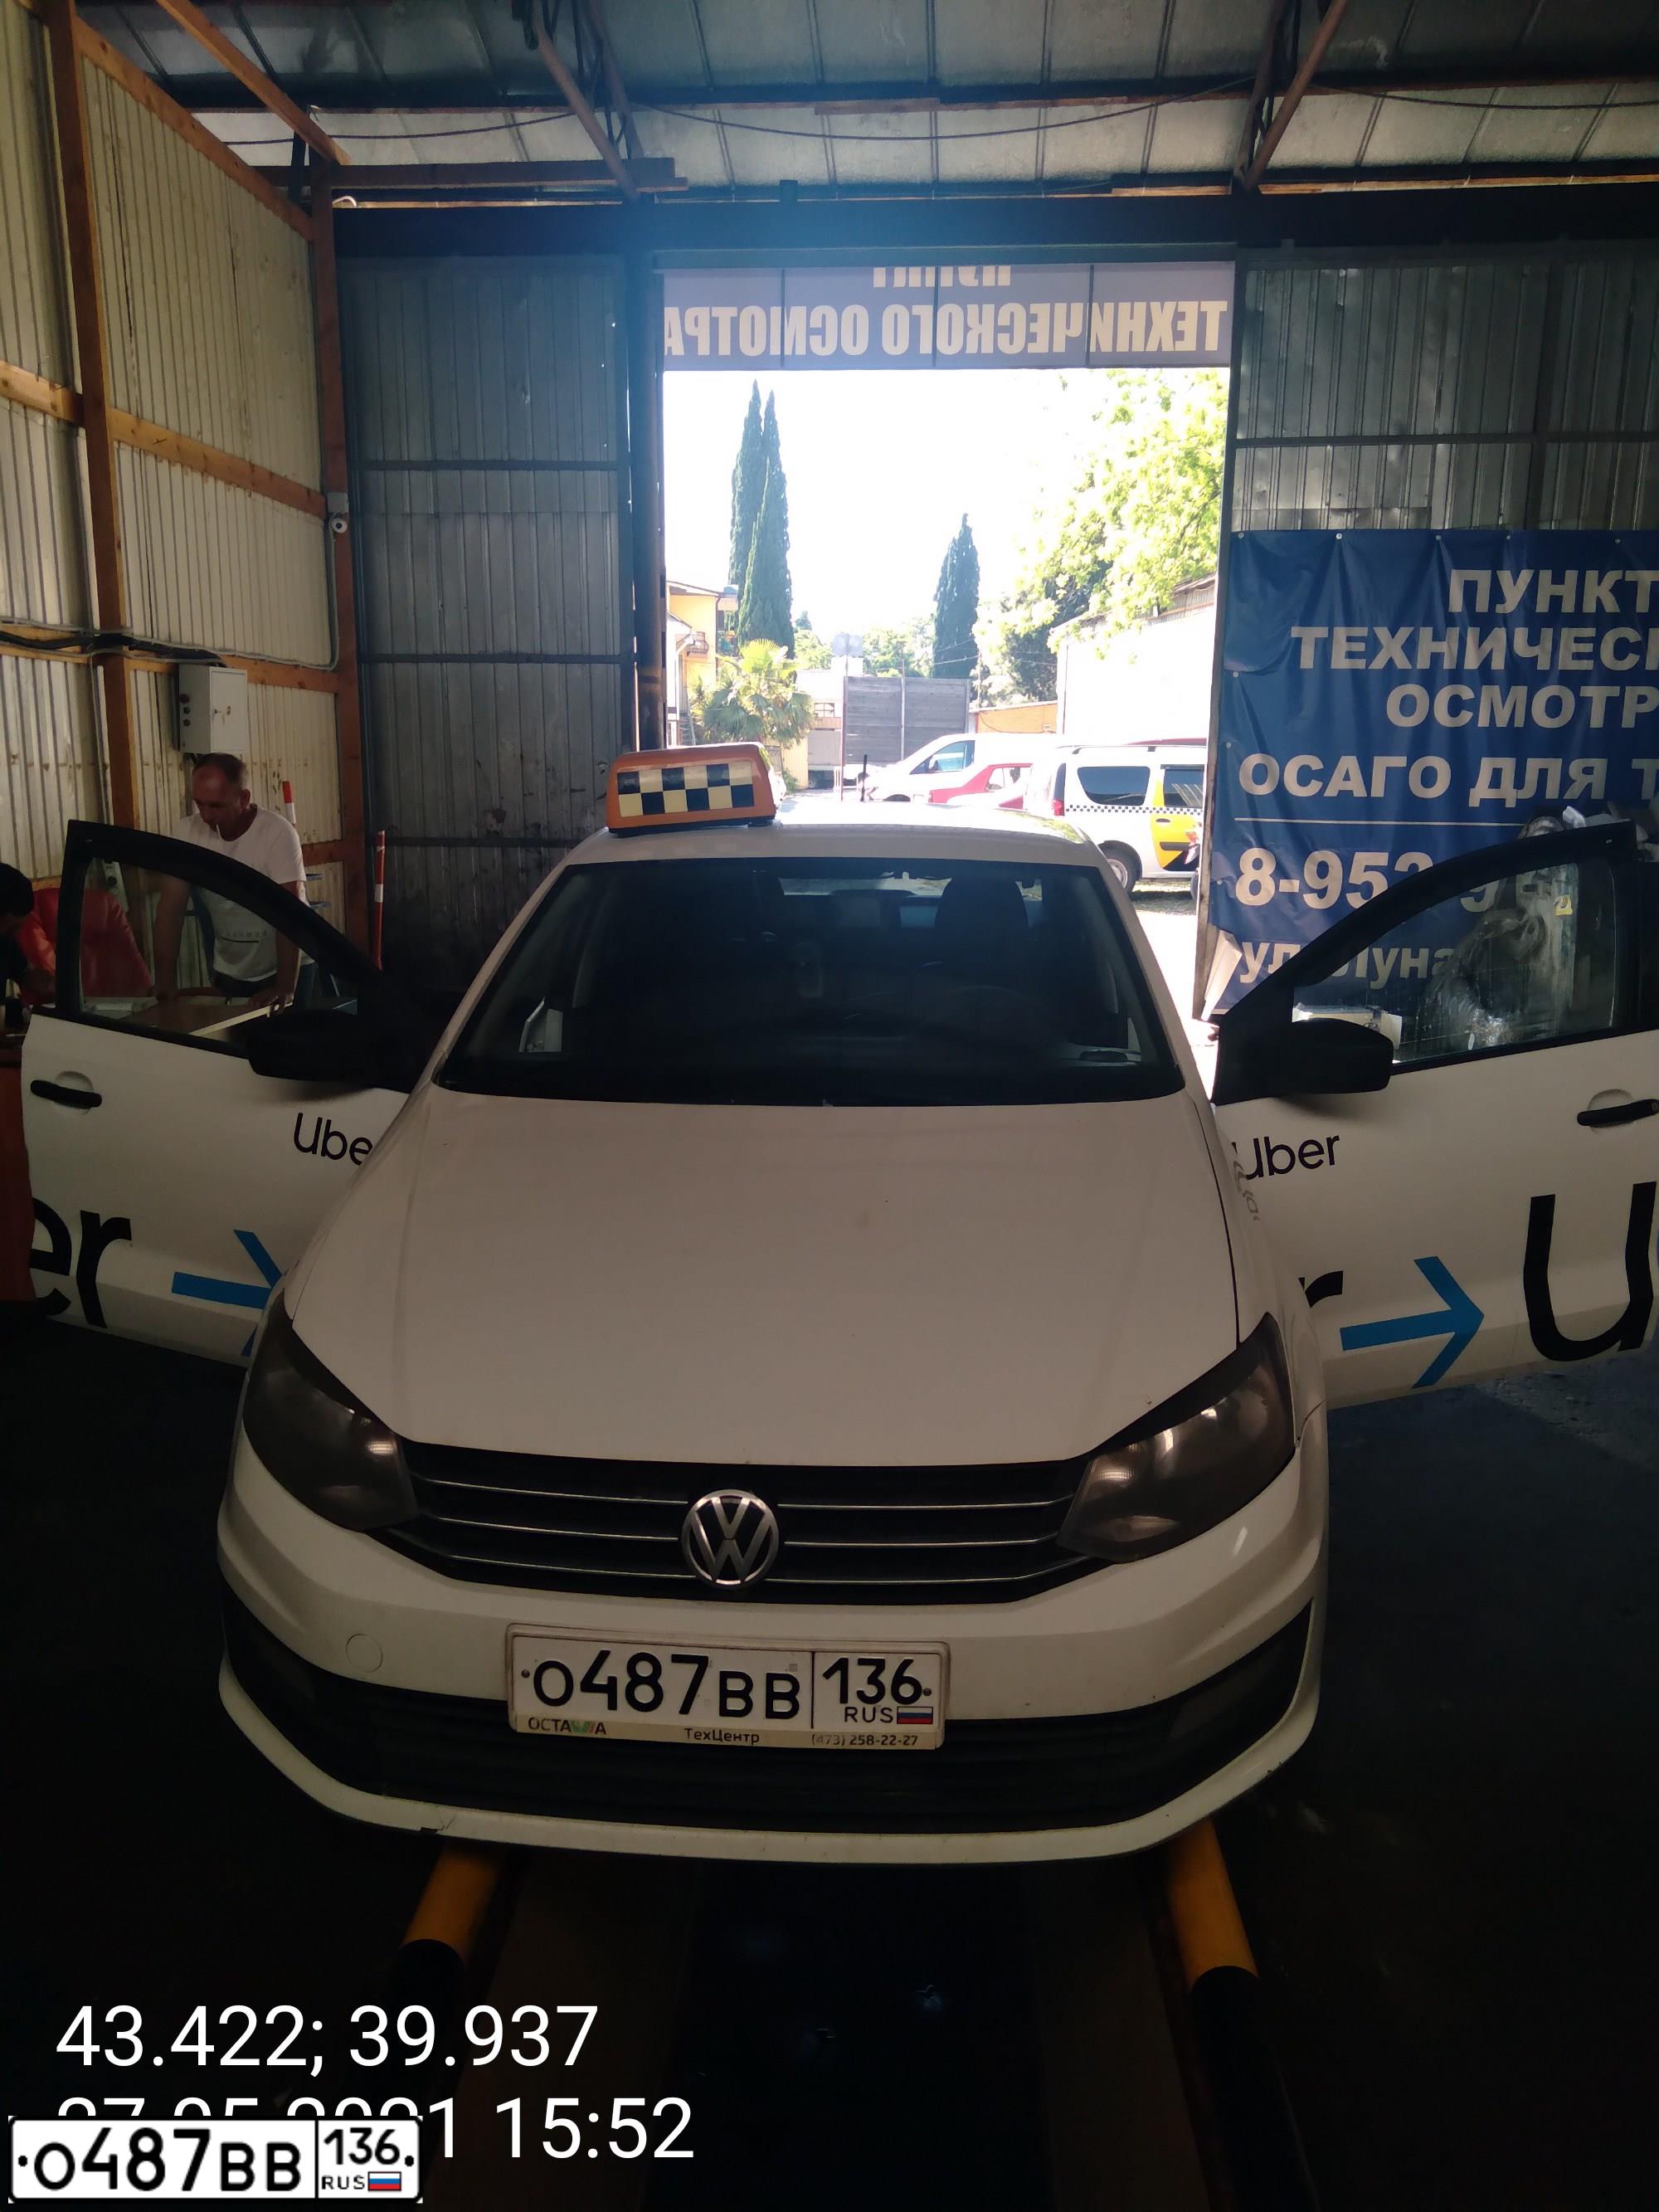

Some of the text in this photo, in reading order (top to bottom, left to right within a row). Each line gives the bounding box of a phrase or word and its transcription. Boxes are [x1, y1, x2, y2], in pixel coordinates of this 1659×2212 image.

[1448, 569, 1659, 613] ПУНКТ
[1386, 684, 1659, 728] ОСМОТР
[1238, 752, 1452, 798] ОСАГО
[1468, 757, 1608, 808] ДЛЯ
[822, 1657, 922, 1704] 136
[684, 1727, 761, 1744] ТехЦентр
[849, 1734, 919, 1747] 258-22-27
[844, 1706, 893, 1724] RUS
